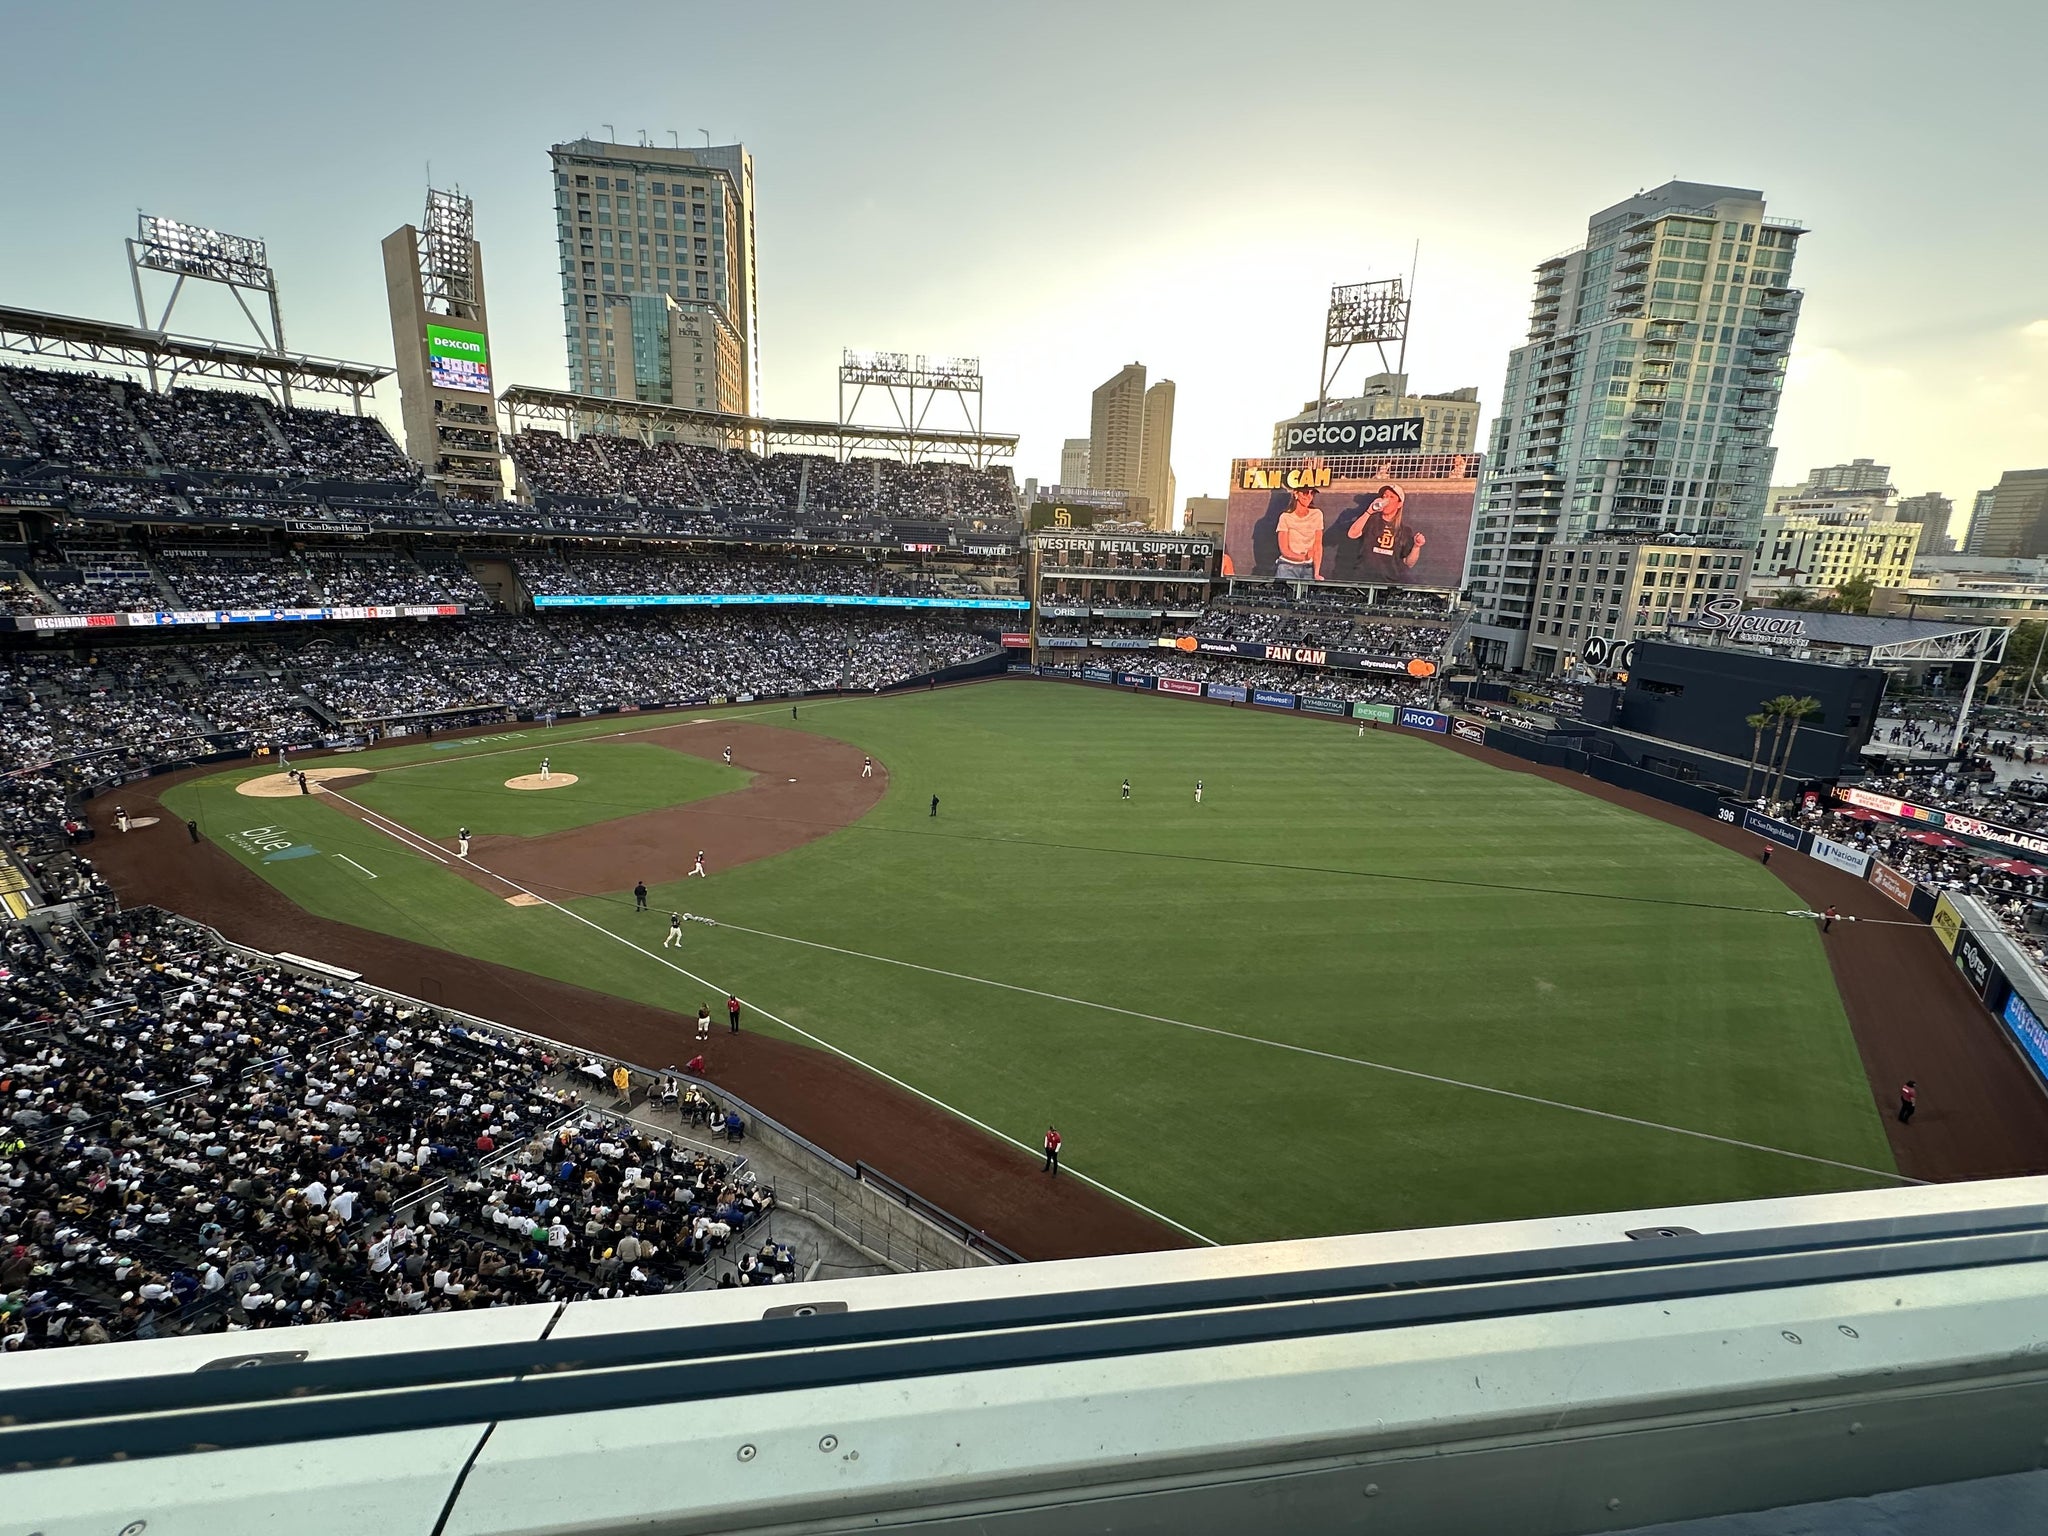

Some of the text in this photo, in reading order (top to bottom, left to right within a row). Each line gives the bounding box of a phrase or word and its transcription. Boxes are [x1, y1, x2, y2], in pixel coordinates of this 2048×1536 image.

[1287, 421, 1421, 450] petco park
[1243, 468, 1331, 489] FAN CAM
[322, 524, 341, 532] Diego
[341, 524, 363, 532] Health
[163, 549, 208, 557] CUTWATER
[968, 546, 1006, 556] CUTWATER
[1038, 537, 1095, 551] WESTERN
[1100, 540, 1139, 553] METAL
[1143, 542, 1188, 555] SUPPLY
[1192, 544, 1212, 556] CO.
[1054, 608, 1076, 616] ORIS
[1698, 598, 1806, 639] Sycuan
[1200, 643, 1231, 652] citycruises
[1265, 646, 1326, 664] FAN CAM
[1361, 660, 1397, 669] citycruises
[1256, 694, 1288, 703] Southwest
[1403, 713, 1434, 727] ARCO
[1455, 721, 1481, 739] Sycuan
[1830, 786, 1850, 802] 1:48
[1718, 808, 1735, 822] 396
[1750, 816, 1795, 841] UC San Diego Health
[240, 825, 292, 851] blue
[1831, 847, 1864, 866] National
[1894, 886, 1908, 900] Park
[550, 1231, 560, 1242] 21
[233, 1271, 248, 1283] 50
